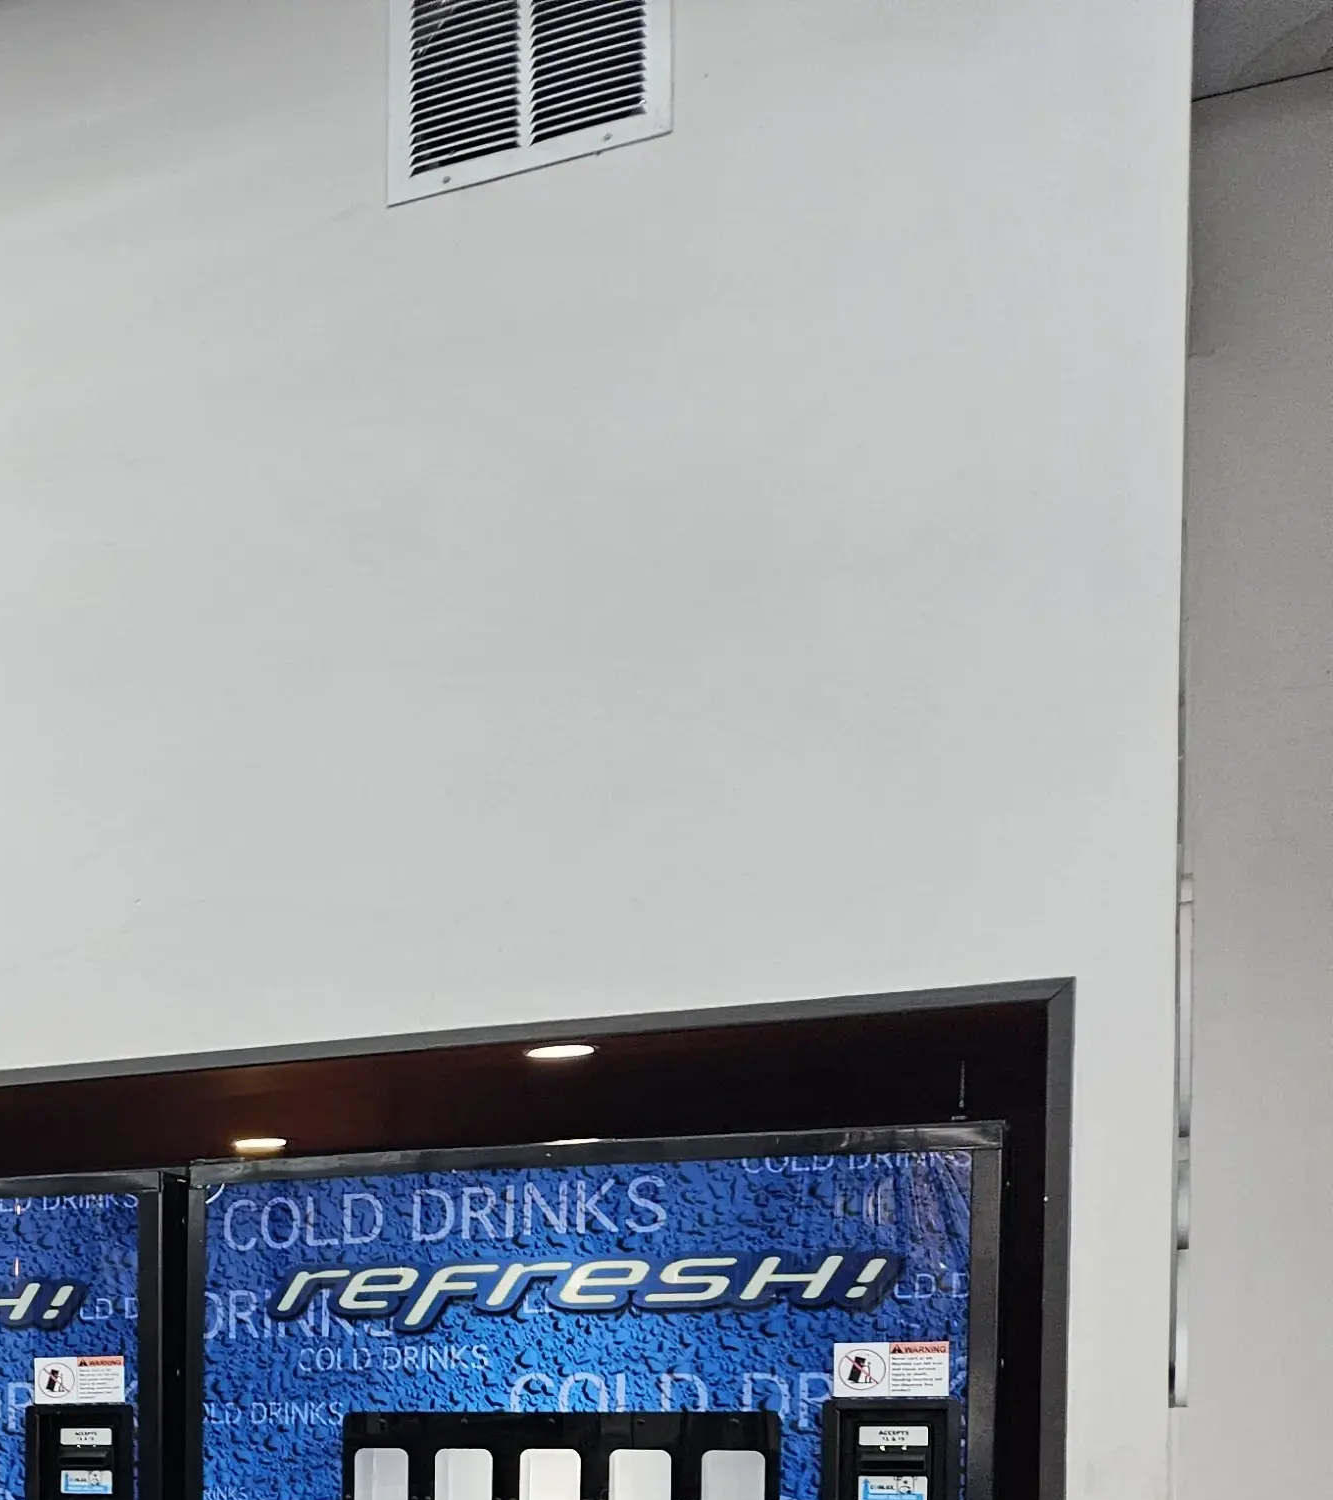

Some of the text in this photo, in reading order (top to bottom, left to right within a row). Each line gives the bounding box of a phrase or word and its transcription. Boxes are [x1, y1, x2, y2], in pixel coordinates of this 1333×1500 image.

[223, 1175, 667, 1251] COLD DRINKS
[299, 1343, 489, 1372] COLD DRINKS
[904, 1345, 947, 1354] WARNING
[87, 1358, 122, 1367] WARNING
[203, 1401, 345, 1425] LD DRINKS
